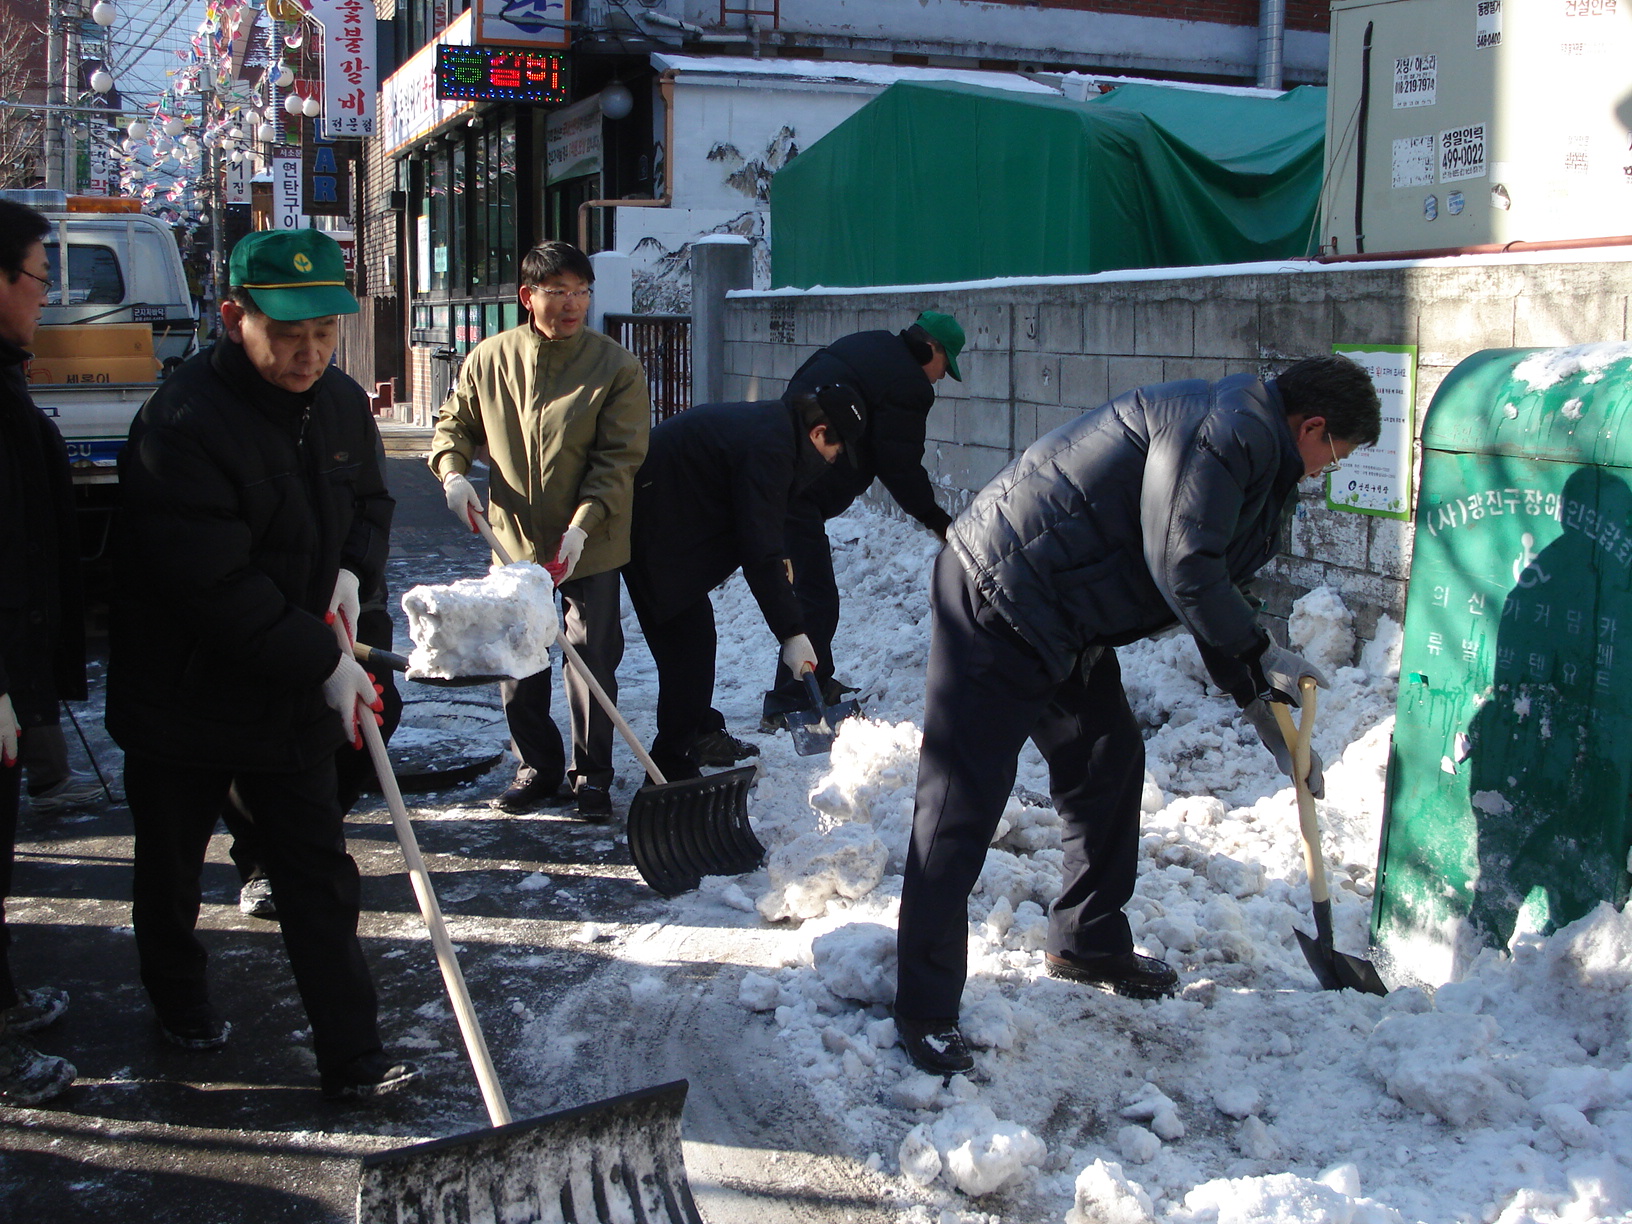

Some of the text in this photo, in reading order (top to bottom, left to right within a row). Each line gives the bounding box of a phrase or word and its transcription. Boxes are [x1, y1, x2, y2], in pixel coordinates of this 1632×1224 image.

[332, 117, 372, 133] 전문점
[1442, 127, 1484, 149] 성일인력
[1443, 142, 1484, 170] 499-0022
[282, 162, 300, 230] 연탄구이
